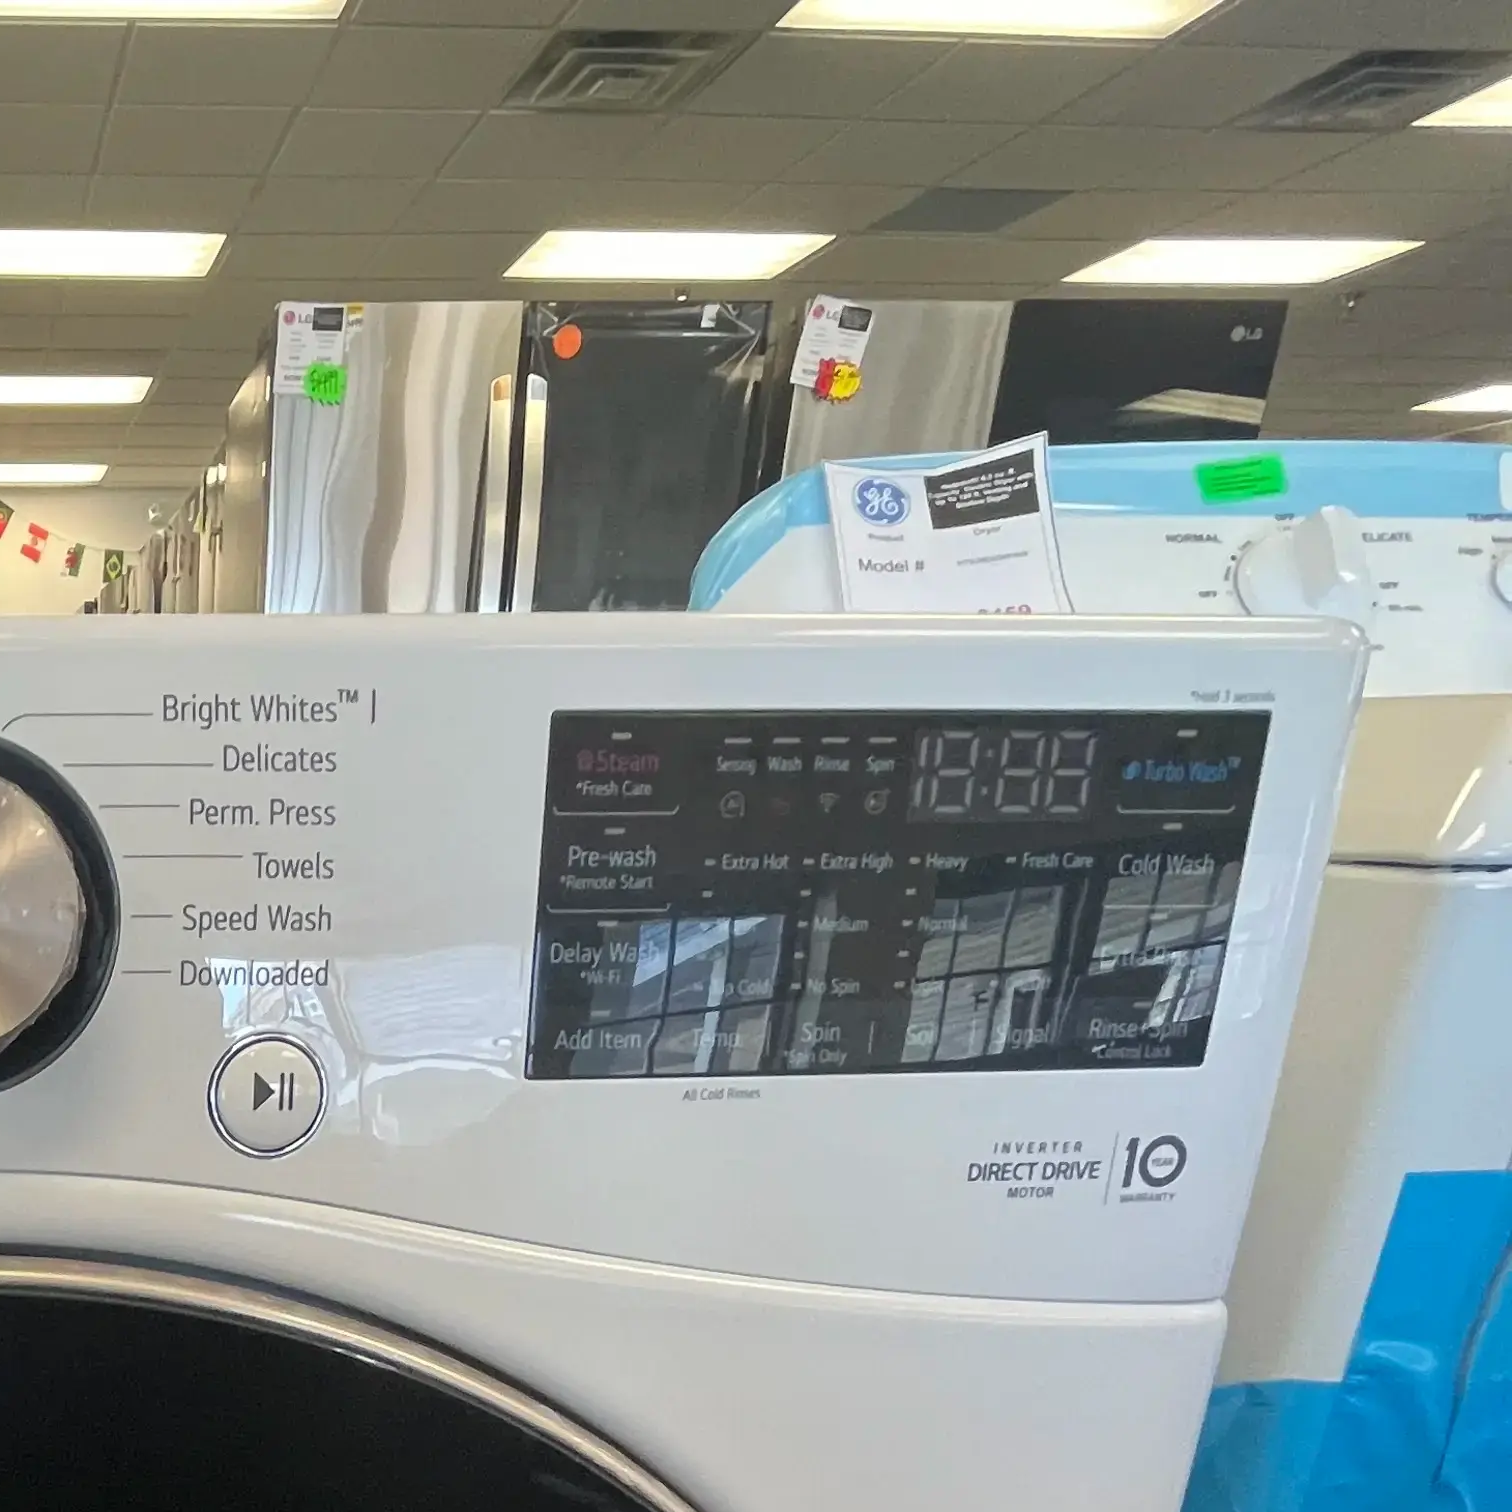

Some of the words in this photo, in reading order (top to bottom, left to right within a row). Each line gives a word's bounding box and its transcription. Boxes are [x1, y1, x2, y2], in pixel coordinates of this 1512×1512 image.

[1166, 533, 1223, 544] NORMAL
[1361, 531, 1413, 542] ELICATE
[858, 558, 909, 572] Model
[915, 560, 925, 571] #
[162, 693, 242, 730] Bright
[223, 743, 337, 773] Delicates
[593, 750, 660, 773] Steam
[767, 755, 803, 772] Wash
[814, 754, 850, 772] Rinse
[866, 753, 895, 776] Spin
[1143, 760, 1183, 782] Turbo
[622, 780, 652, 796] Care
[189, 798, 260, 826] Perm.
[269, 798, 336, 826] Press
[252, 851, 335, 880] Towels
[568, 844, 656, 868] Pre-wash
[721, 853, 759, 870] Extra
[763, 853, 789, 870] Hot
[820, 853, 857, 870] Extra
[860, 852, 893, 873] High
[925, 853, 969, 870] Heavy
[1021, 851, 1059, 868] Fresh
[1062, 851, 1094, 868] Care
[1118, 852, 1160, 874] Cold
[1166, 853, 1215, 876] Wash
[620, 873, 653, 889] Start
[182, 903, 258, 939] Speed
[267, 904, 332, 932] Wash
[550, 942, 603, 968] Delay
[609, 942, 661, 965] Wash
[180, 958, 329, 987] Downloaded
[831, 977, 861, 998] Spin
[554, 1029, 594, 1051] Add
[599, 1030, 642, 1049] Item
[800, 1022, 841, 1046] Spin
[700, 1087, 724, 1101] Cold
[993, 1140, 1083, 1155] INVERTER
[967, 1162, 1038, 1182] DIRECT
[1041, 1160, 1101, 1180] DRIVE
[1122, 1134, 1187, 1188] 10
[1006, 1186, 1055, 1198] MOTOR
